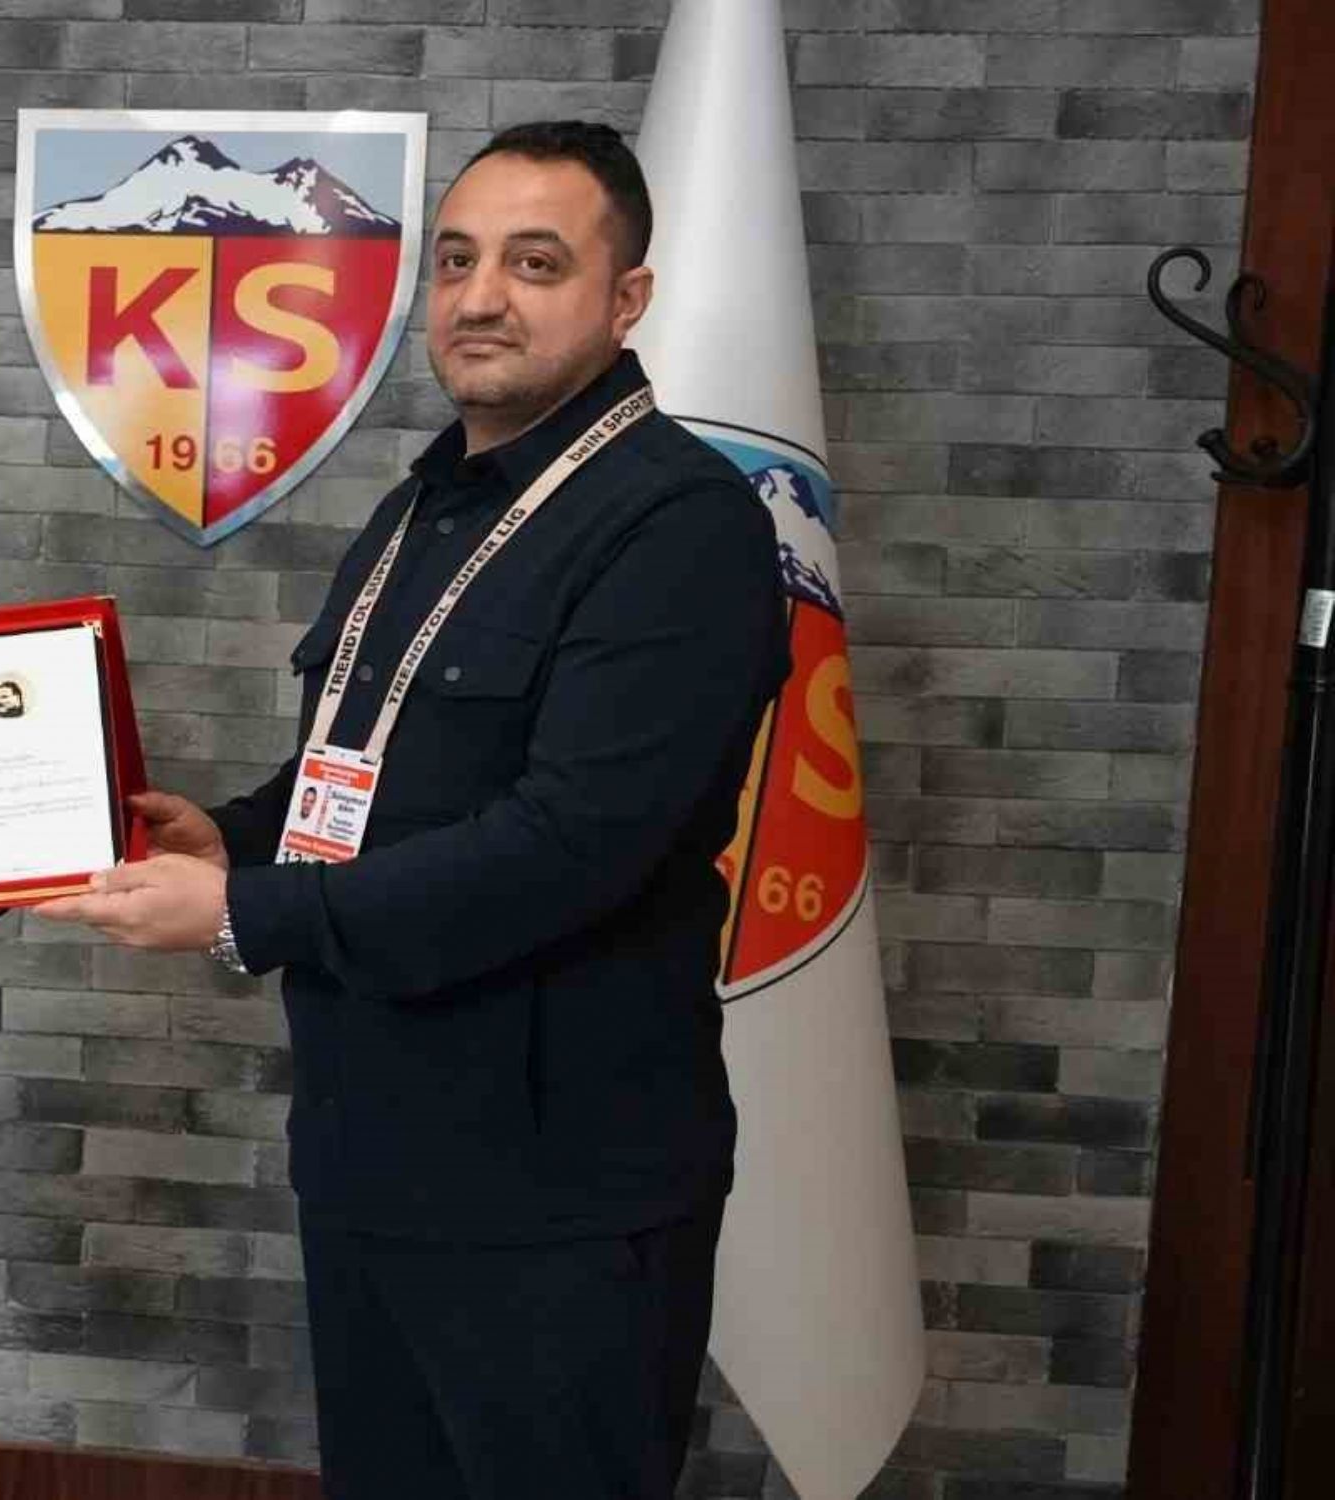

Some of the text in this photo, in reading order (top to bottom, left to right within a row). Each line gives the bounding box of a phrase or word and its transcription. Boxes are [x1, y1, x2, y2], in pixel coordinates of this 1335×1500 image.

[86, 262, 341, 395] KS
[327, 600, 371, 697] TRENDYOL
[388, 603, 451, 704] TRENDYOL
